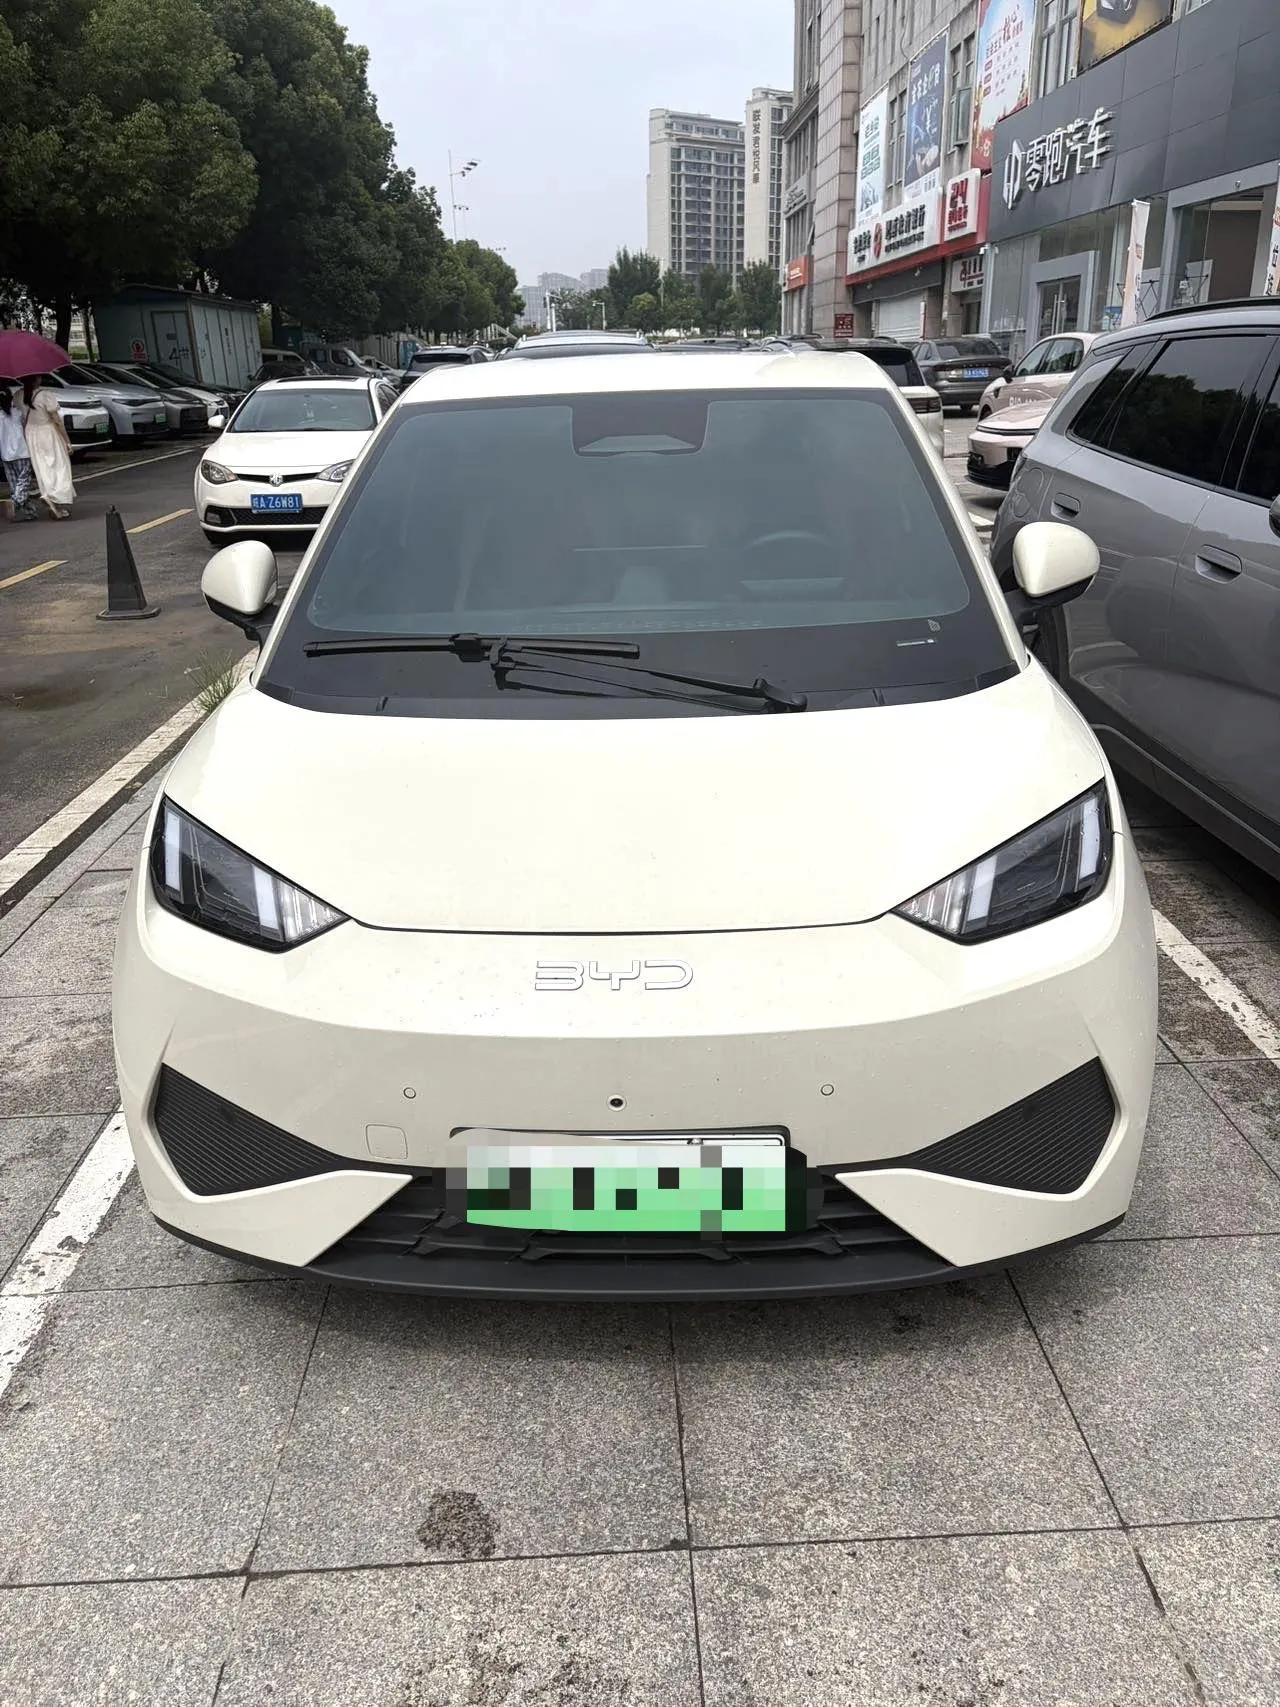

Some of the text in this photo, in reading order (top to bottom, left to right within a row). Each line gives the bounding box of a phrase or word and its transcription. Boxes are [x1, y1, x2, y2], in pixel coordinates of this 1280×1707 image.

[1025, 107, 1115, 192] 零跑汽车
[534, 959, 694, 991] BYD
